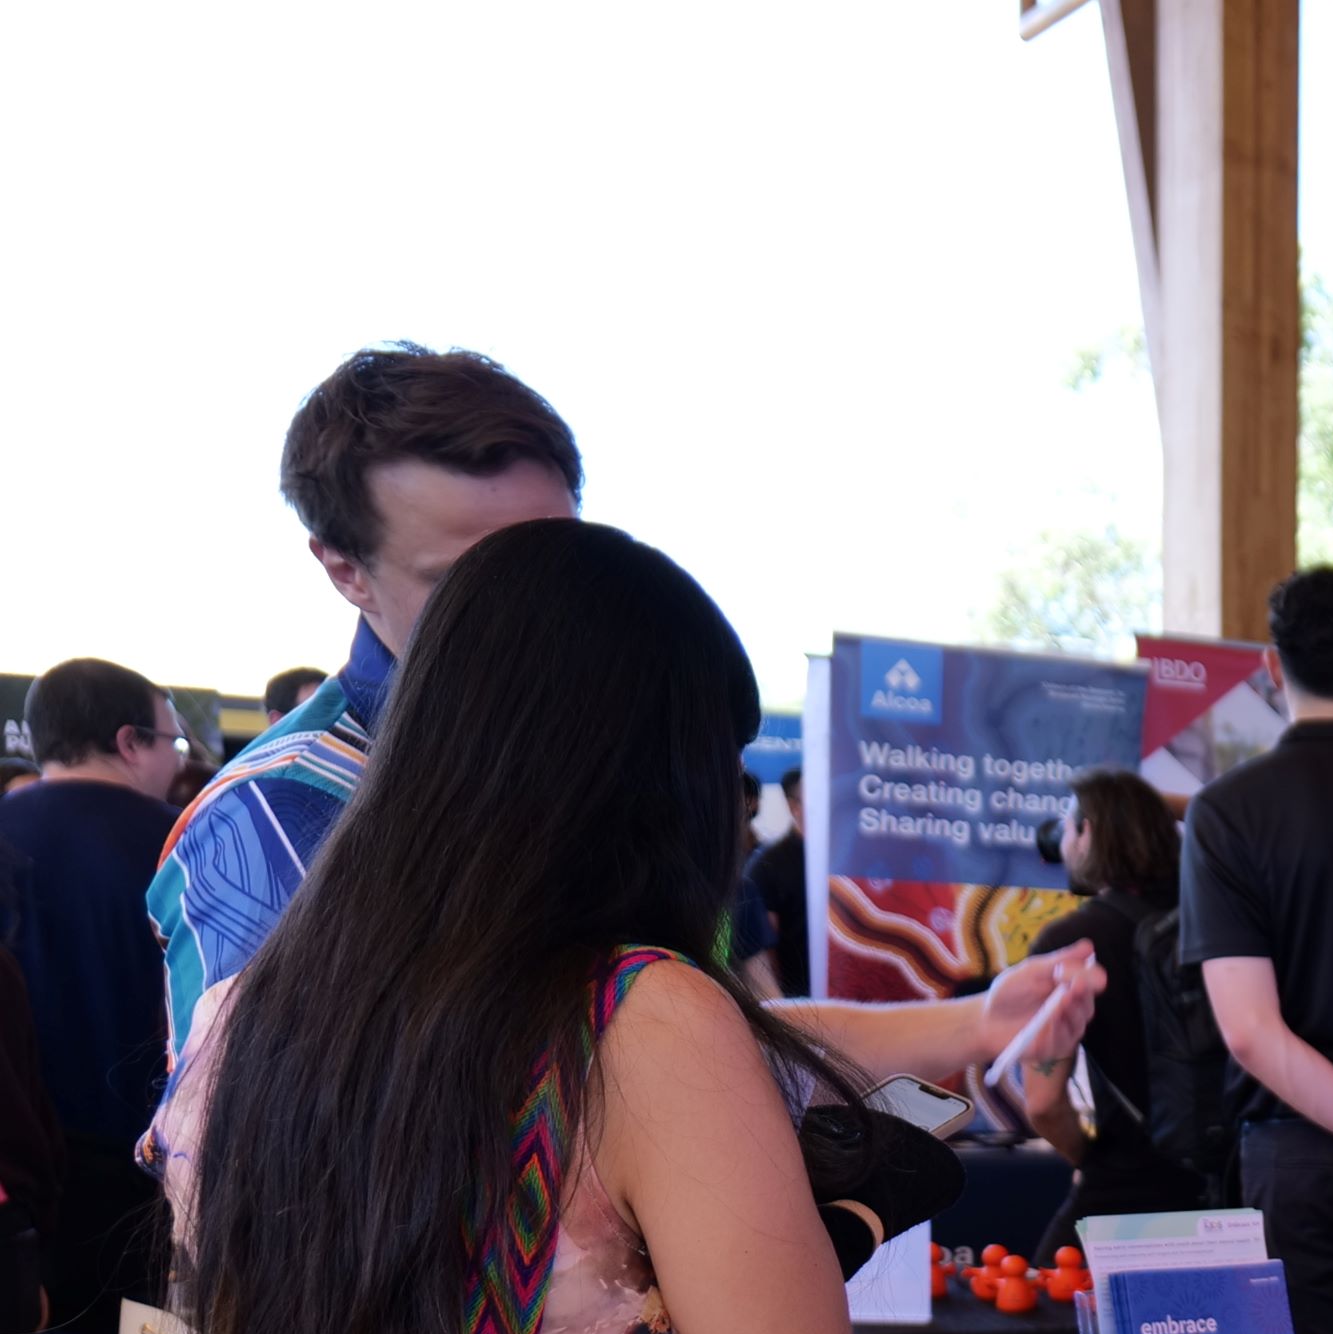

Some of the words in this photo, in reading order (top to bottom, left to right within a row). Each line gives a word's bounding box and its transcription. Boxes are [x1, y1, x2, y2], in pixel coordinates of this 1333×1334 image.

[1160, 659, 1206, 680] BDO
[872, 690, 933, 713] Alcoa
[859, 741, 974, 782] Walking
[859, 775, 980, 814] Creating
[989, 787, 1074, 821] chang
[859, 809, 970, 844] Sharing
[979, 819, 1036, 845] valu
